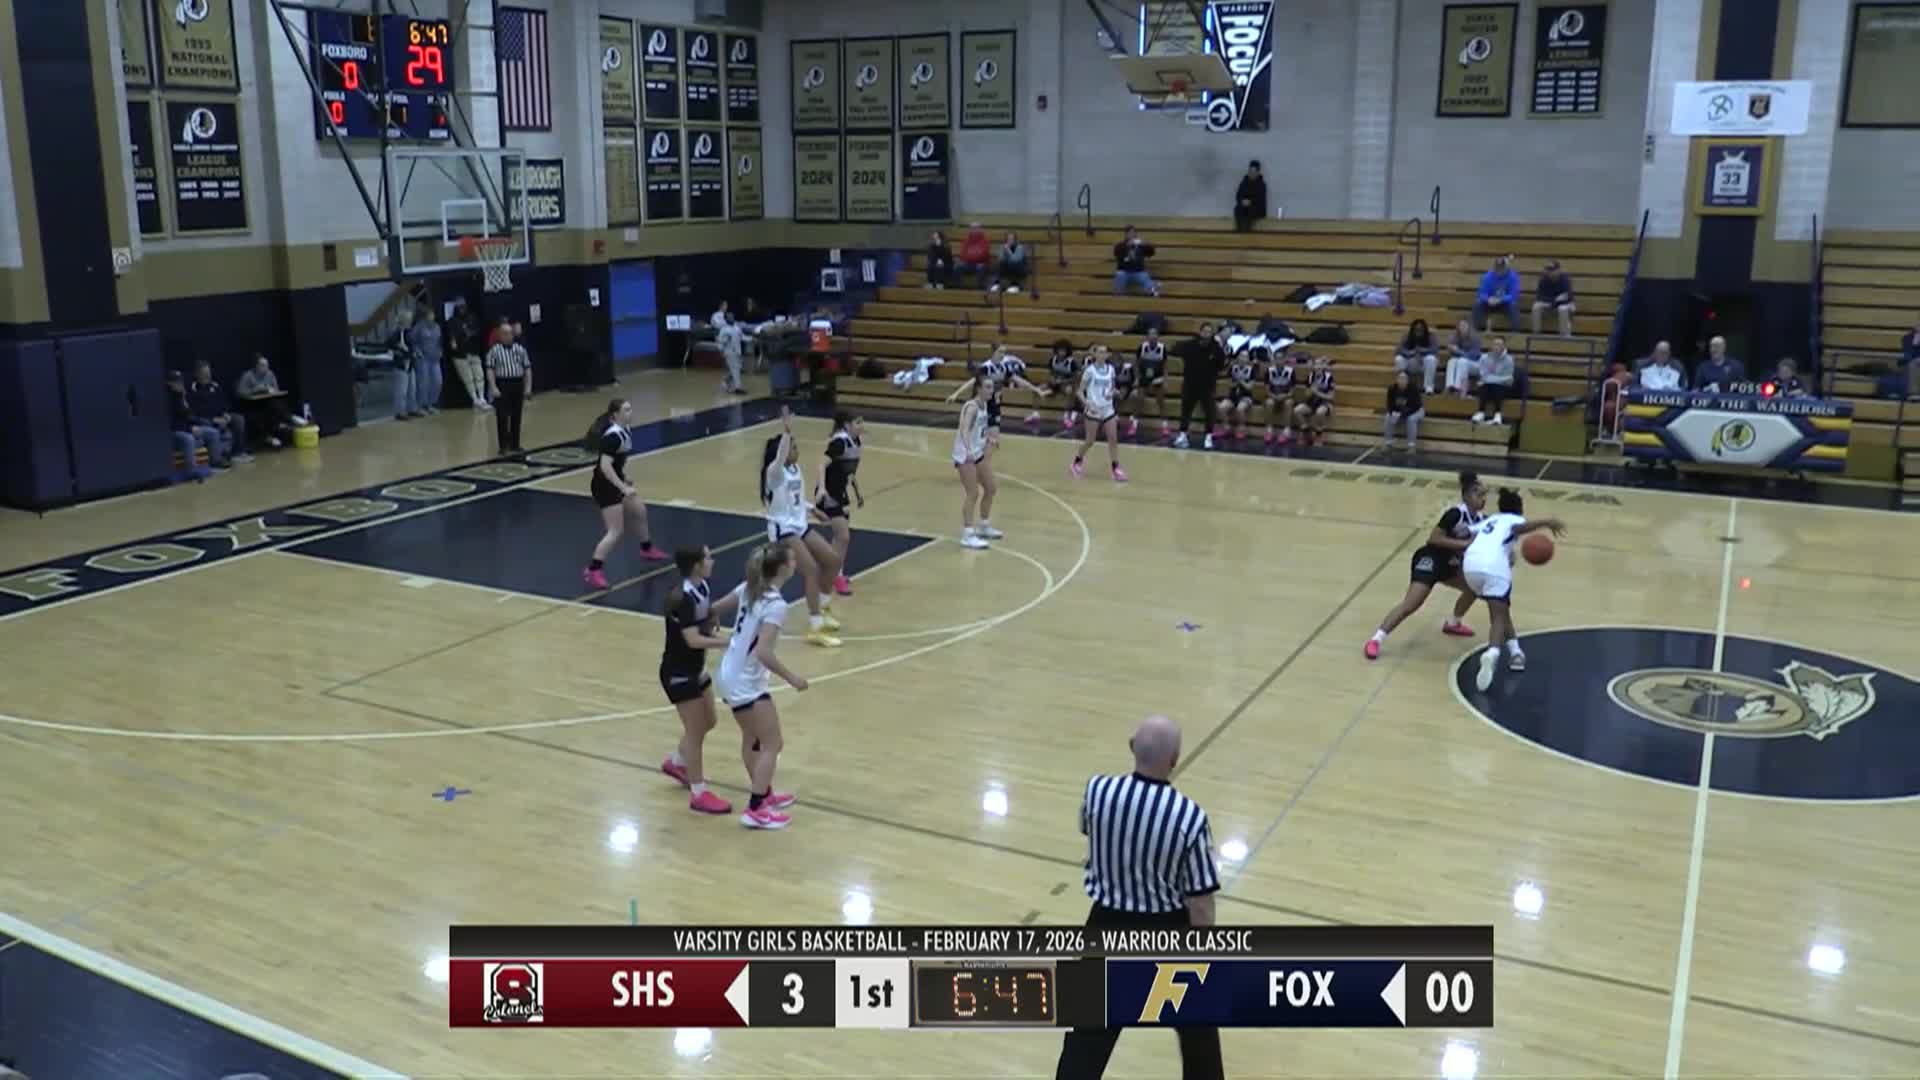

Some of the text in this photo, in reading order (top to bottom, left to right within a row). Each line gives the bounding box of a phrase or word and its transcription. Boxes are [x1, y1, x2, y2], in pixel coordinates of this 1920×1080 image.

[1222, 4, 1264, 12] WARRIOR
[409, 21, 448, 45] 6:47
[171, 52, 227, 65] NATIONAL
[321, 43, 367, 60] FOXBORO
[1221, 15, 1265, 86] FOCUS
[167, 65, 233, 79] CHAMPIONS
[407, 44, 444, 85] 29
[342, 61, 359, 90] 0
[331, 101, 344, 124] 0
[186, 154, 229, 166] LEAGUE
[175, 167, 241, 178] CHAMPIONS
[801, 170, 833, 185] 2024
[852, 170, 886, 185] 2024
[1721, 171, 1741, 185] 33
[1643, 394, 1837, 416] HOME OF THE WARRIORS
[0, 446, 602, 601] FOXBORO
[1482, 518, 1498, 535] 5
